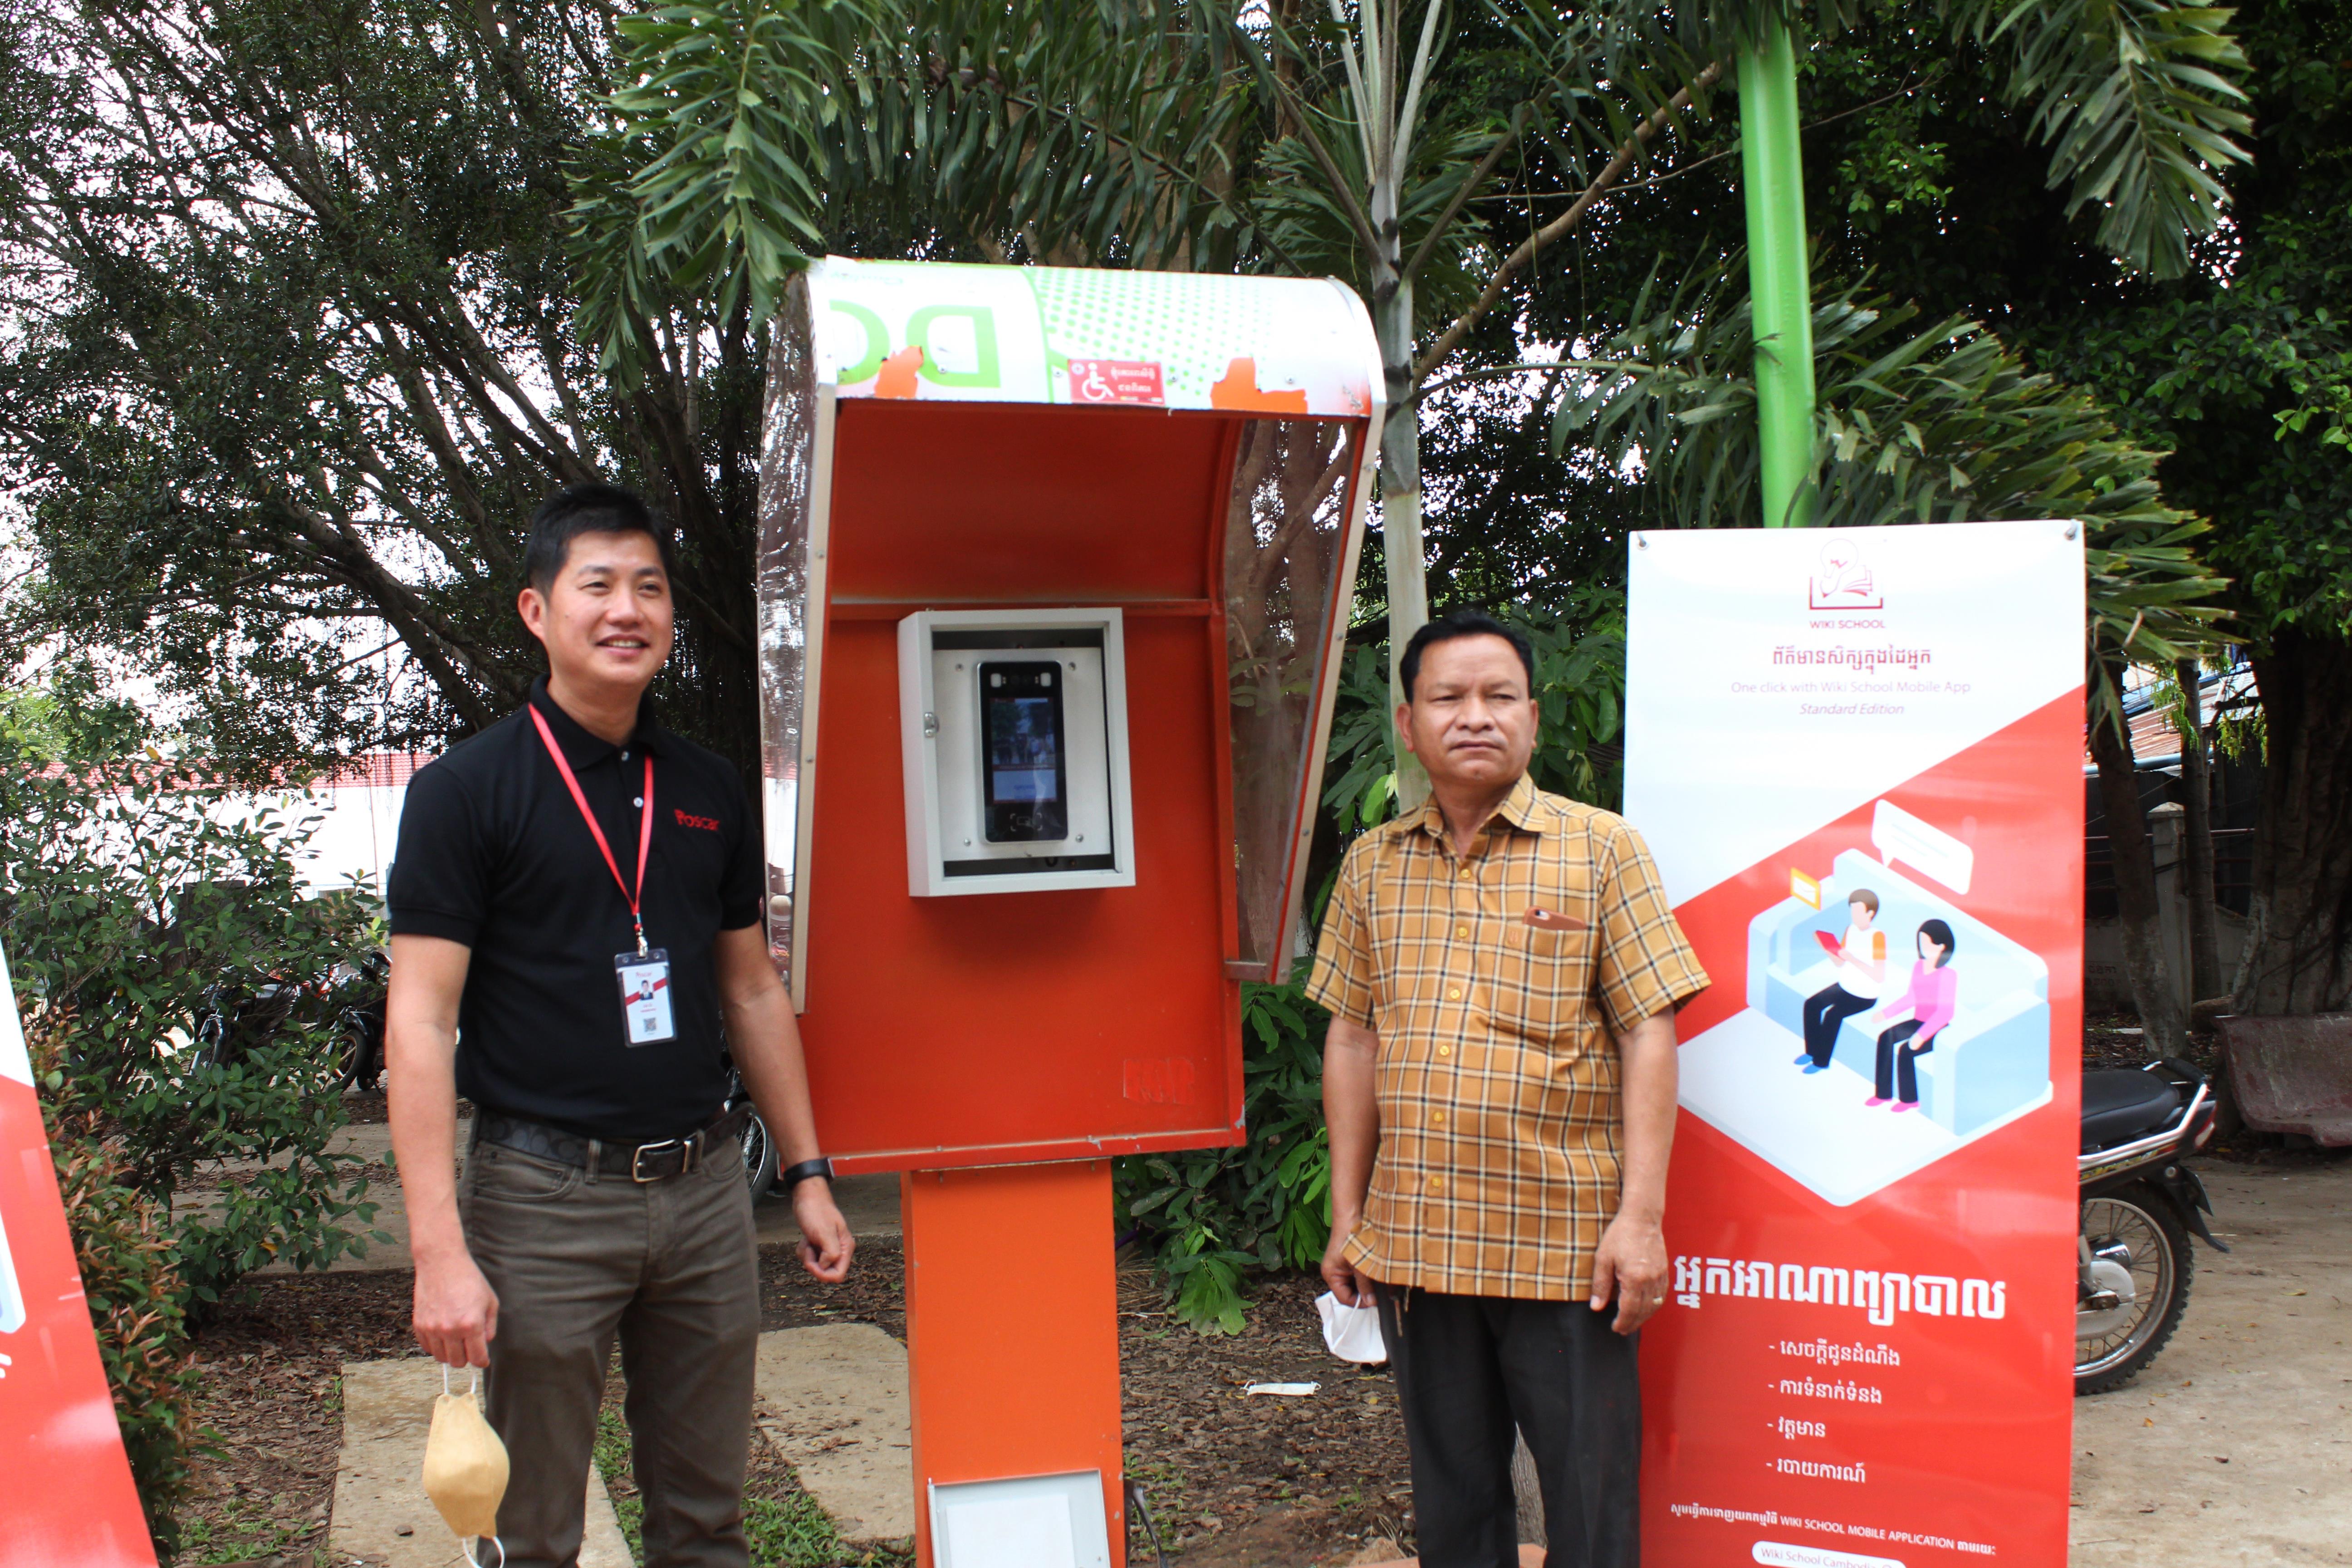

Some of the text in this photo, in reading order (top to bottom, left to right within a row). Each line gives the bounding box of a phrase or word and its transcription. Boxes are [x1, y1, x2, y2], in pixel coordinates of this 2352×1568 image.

[1809, 619, 1886, 629] WIKI SCHOOL
[1731, 681, 1971, 695] One click with Wiki School Mobile App
[1799, 703, 1905, 715] Standard Edition
[1780, 1515, 1802, 1529] WIKI
[1804, 1518, 1845, 1534] SCHOOL
[1847, 1524, 1886, 1540] MOBILE
[1887, 1530, 1955, 1549] APPLICATION
[1761, 1547, 1783, 1559] Wiki
[1785, 1550, 1821, 1565] School
